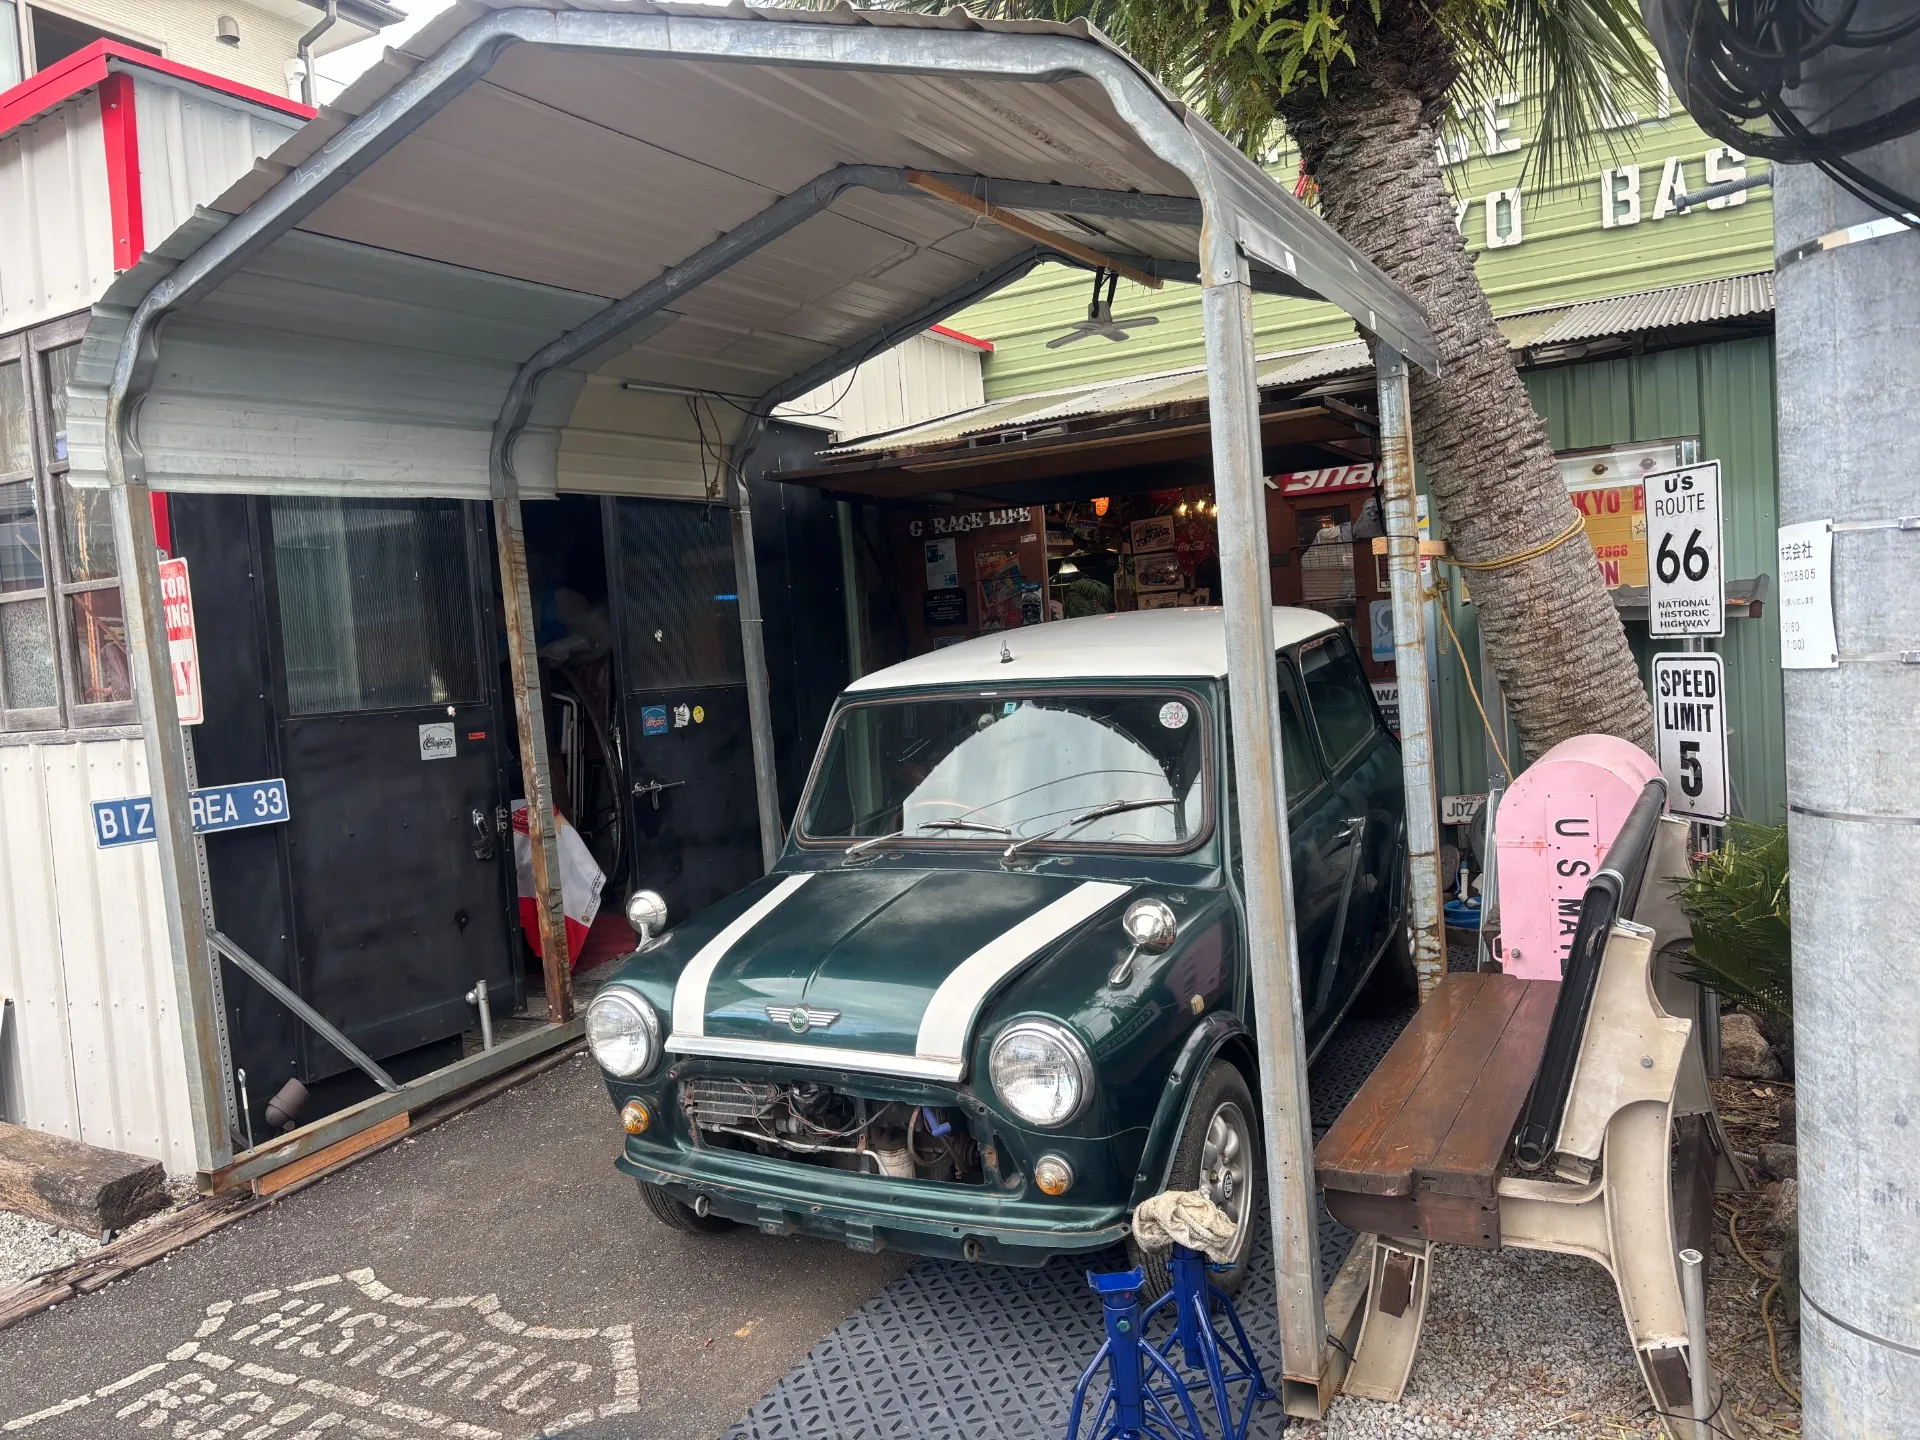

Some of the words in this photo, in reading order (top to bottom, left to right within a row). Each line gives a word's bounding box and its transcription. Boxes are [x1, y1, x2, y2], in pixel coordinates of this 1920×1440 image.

[1571, 489, 1621, 517] KYO
[1655, 493, 1706, 517] ROUTE
[988, 506, 1032, 526] LIFE
[1656, 528, 1710, 584] 66
[164, 603, 190, 627] ING
[1658, 598, 1711, 609] NATIONAL
[1660, 608, 1710, 618] HISTORIC
[1660, 619, 1711, 629] HIGHWAY
[1660, 669, 1716, 698] SPEED
[1168, 711, 1180, 721] 20
[1663, 702, 1714, 732] LIMIT
[1679, 741, 1703, 797] 5
[99, 804, 154, 840] BIZ
[190, 796, 239, 827] REA
[253, 787, 284, 818] 33
[791, 1016, 806, 1024] MINI
[227, 1298, 593, 1416] HISTORIC
